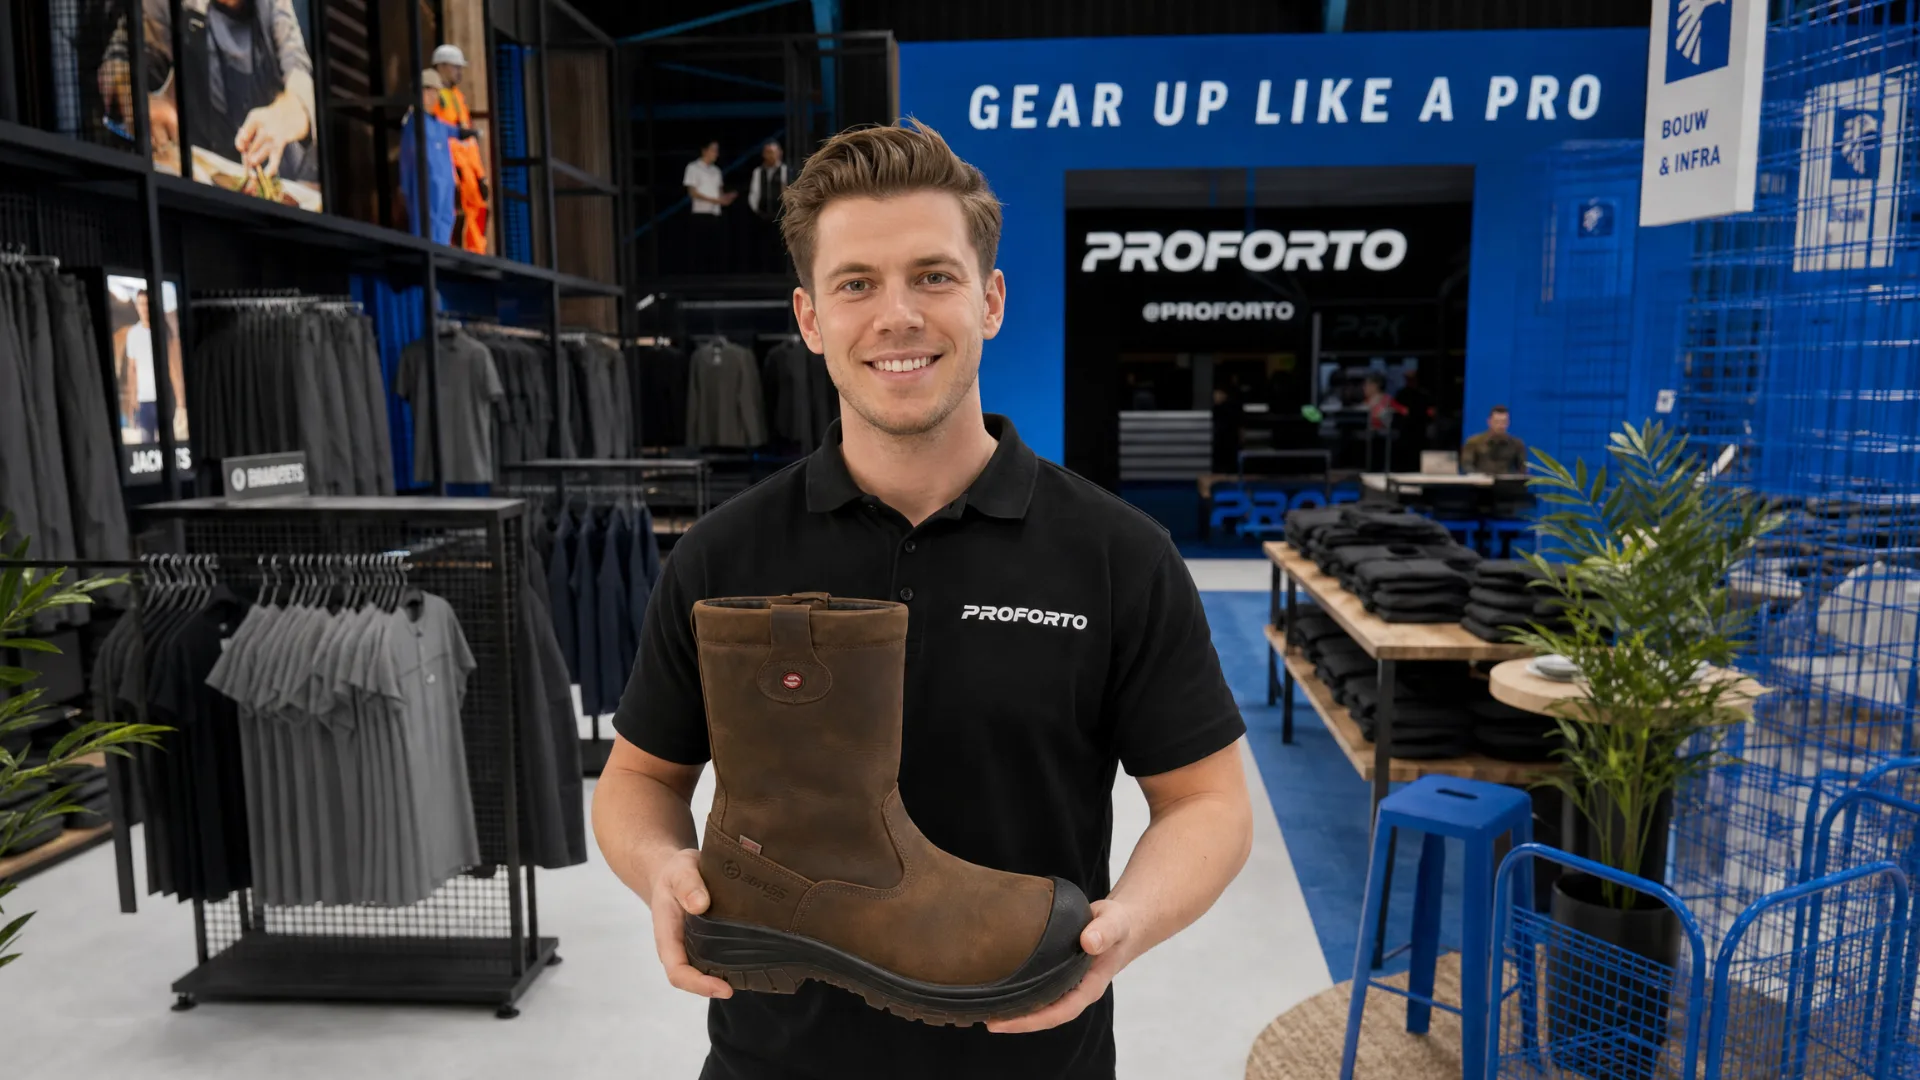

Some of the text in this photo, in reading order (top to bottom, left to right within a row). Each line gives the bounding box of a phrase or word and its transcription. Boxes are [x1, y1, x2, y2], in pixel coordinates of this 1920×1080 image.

[968, 74, 1602, 130] GEAR UP LIKE A PRO
[1661, 108, 1709, 140] BOUW
[1658, 144, 1721, 176] & INFRA
[1081, 229, 1408, 272] PROFORTO
[1142, 301, 1295, 322] @PROFORTO
[961, 604, 1088, 630] PROFORTO
